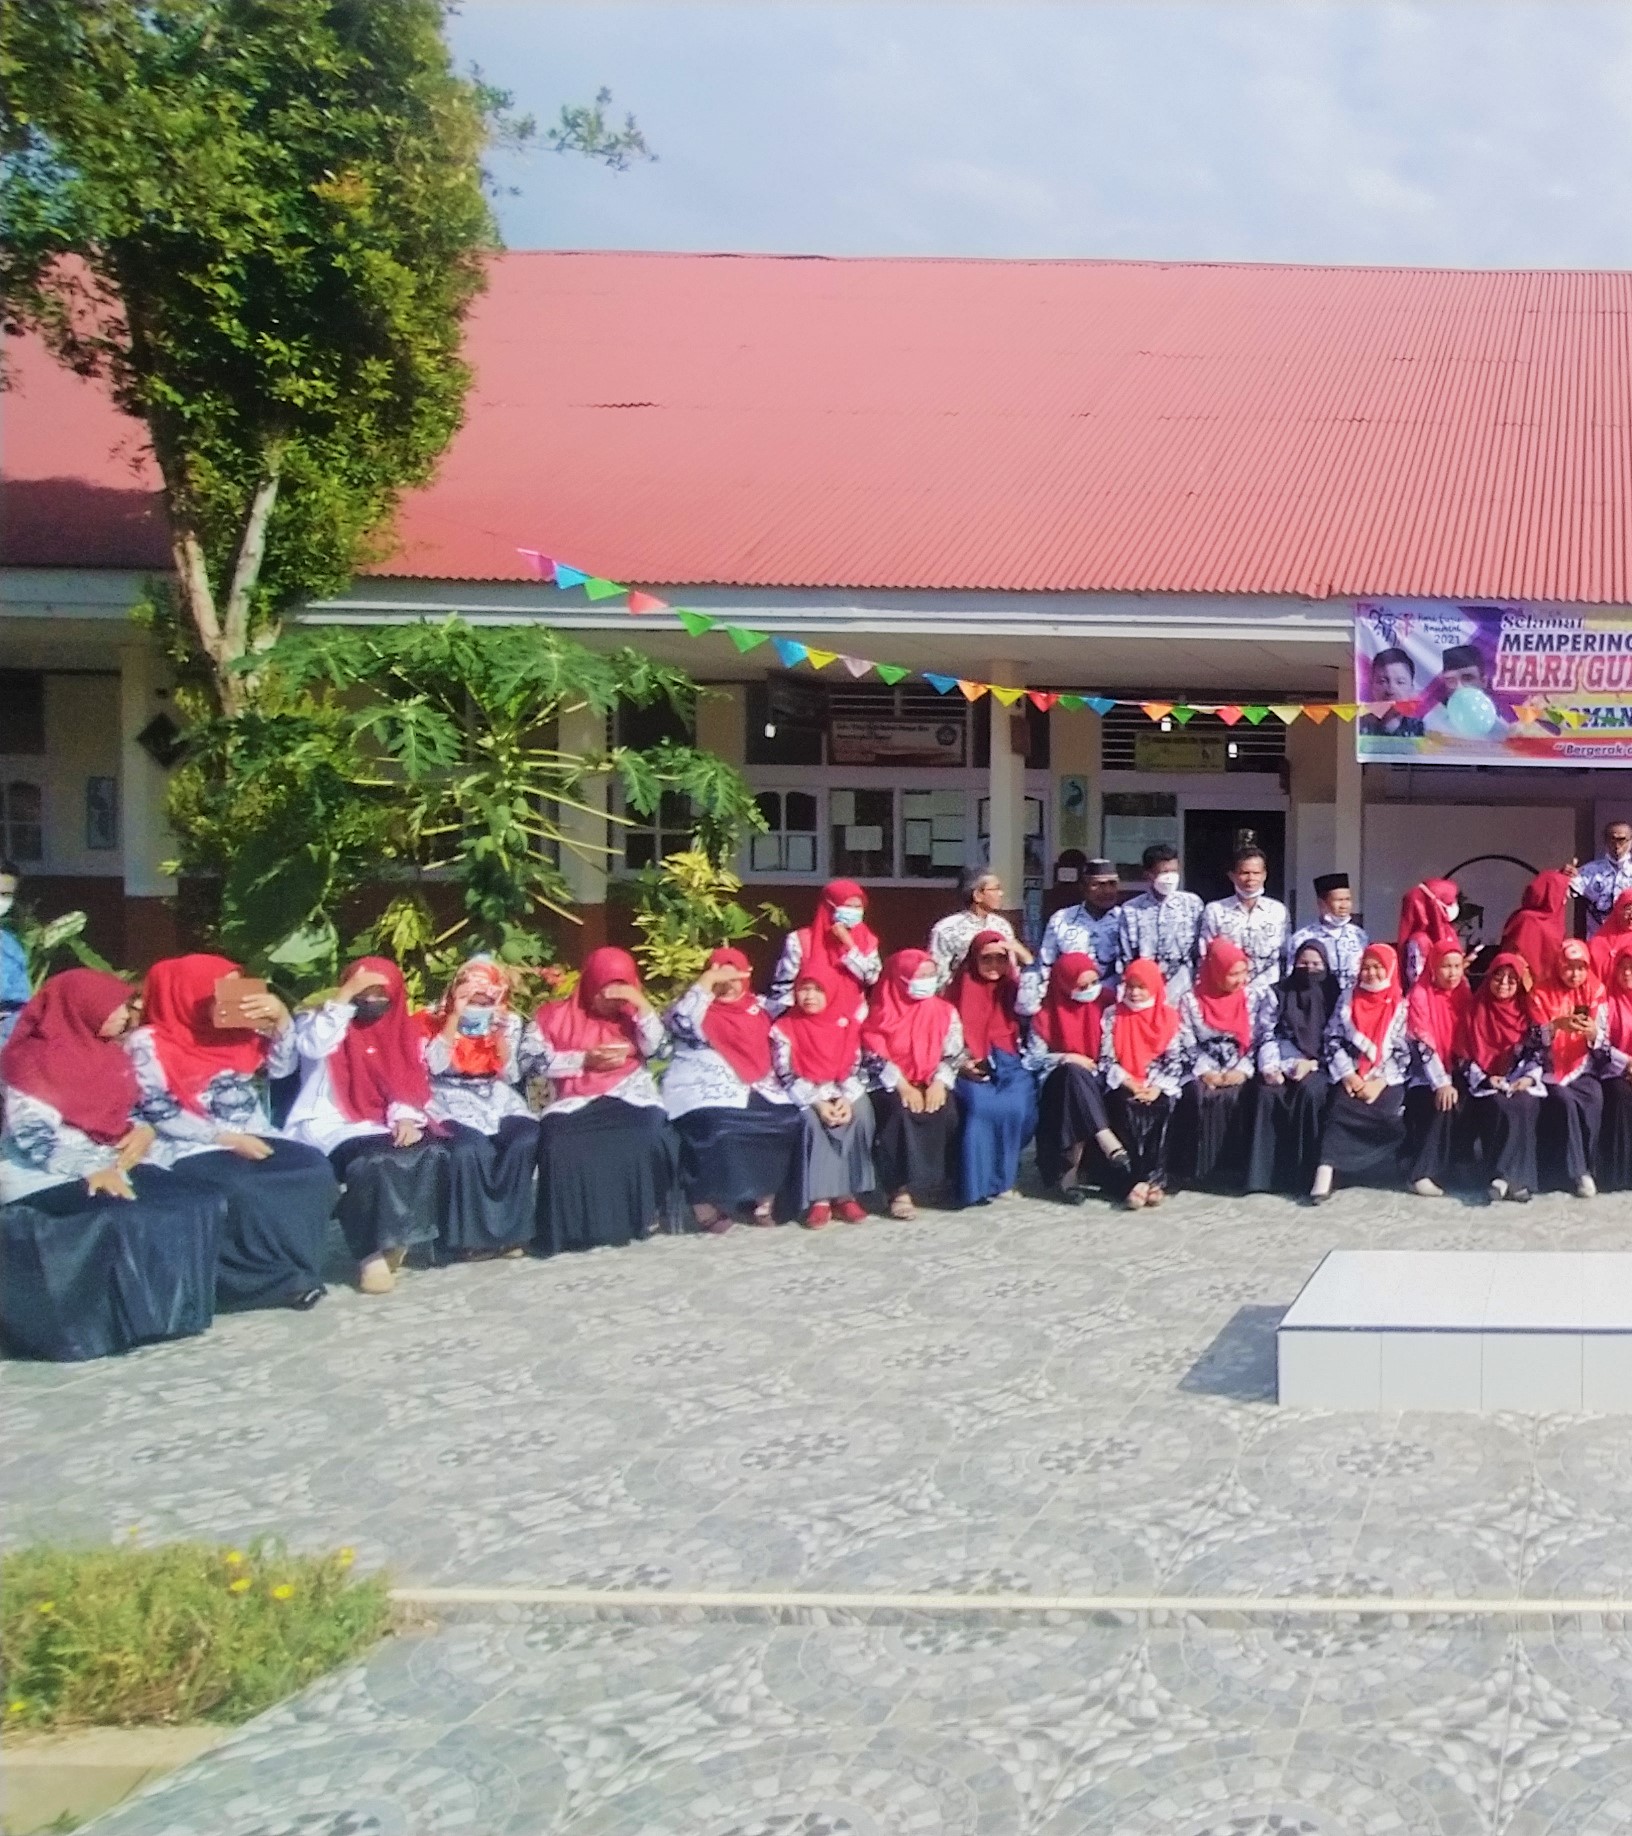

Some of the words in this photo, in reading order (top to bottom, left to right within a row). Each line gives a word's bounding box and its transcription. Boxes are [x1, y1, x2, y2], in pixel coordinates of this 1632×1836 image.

[1502, 614, 1583, 630] Selamat
[1433, 634, 1460, 645] 2021
[1496, 654, 1574, 689] HARI
